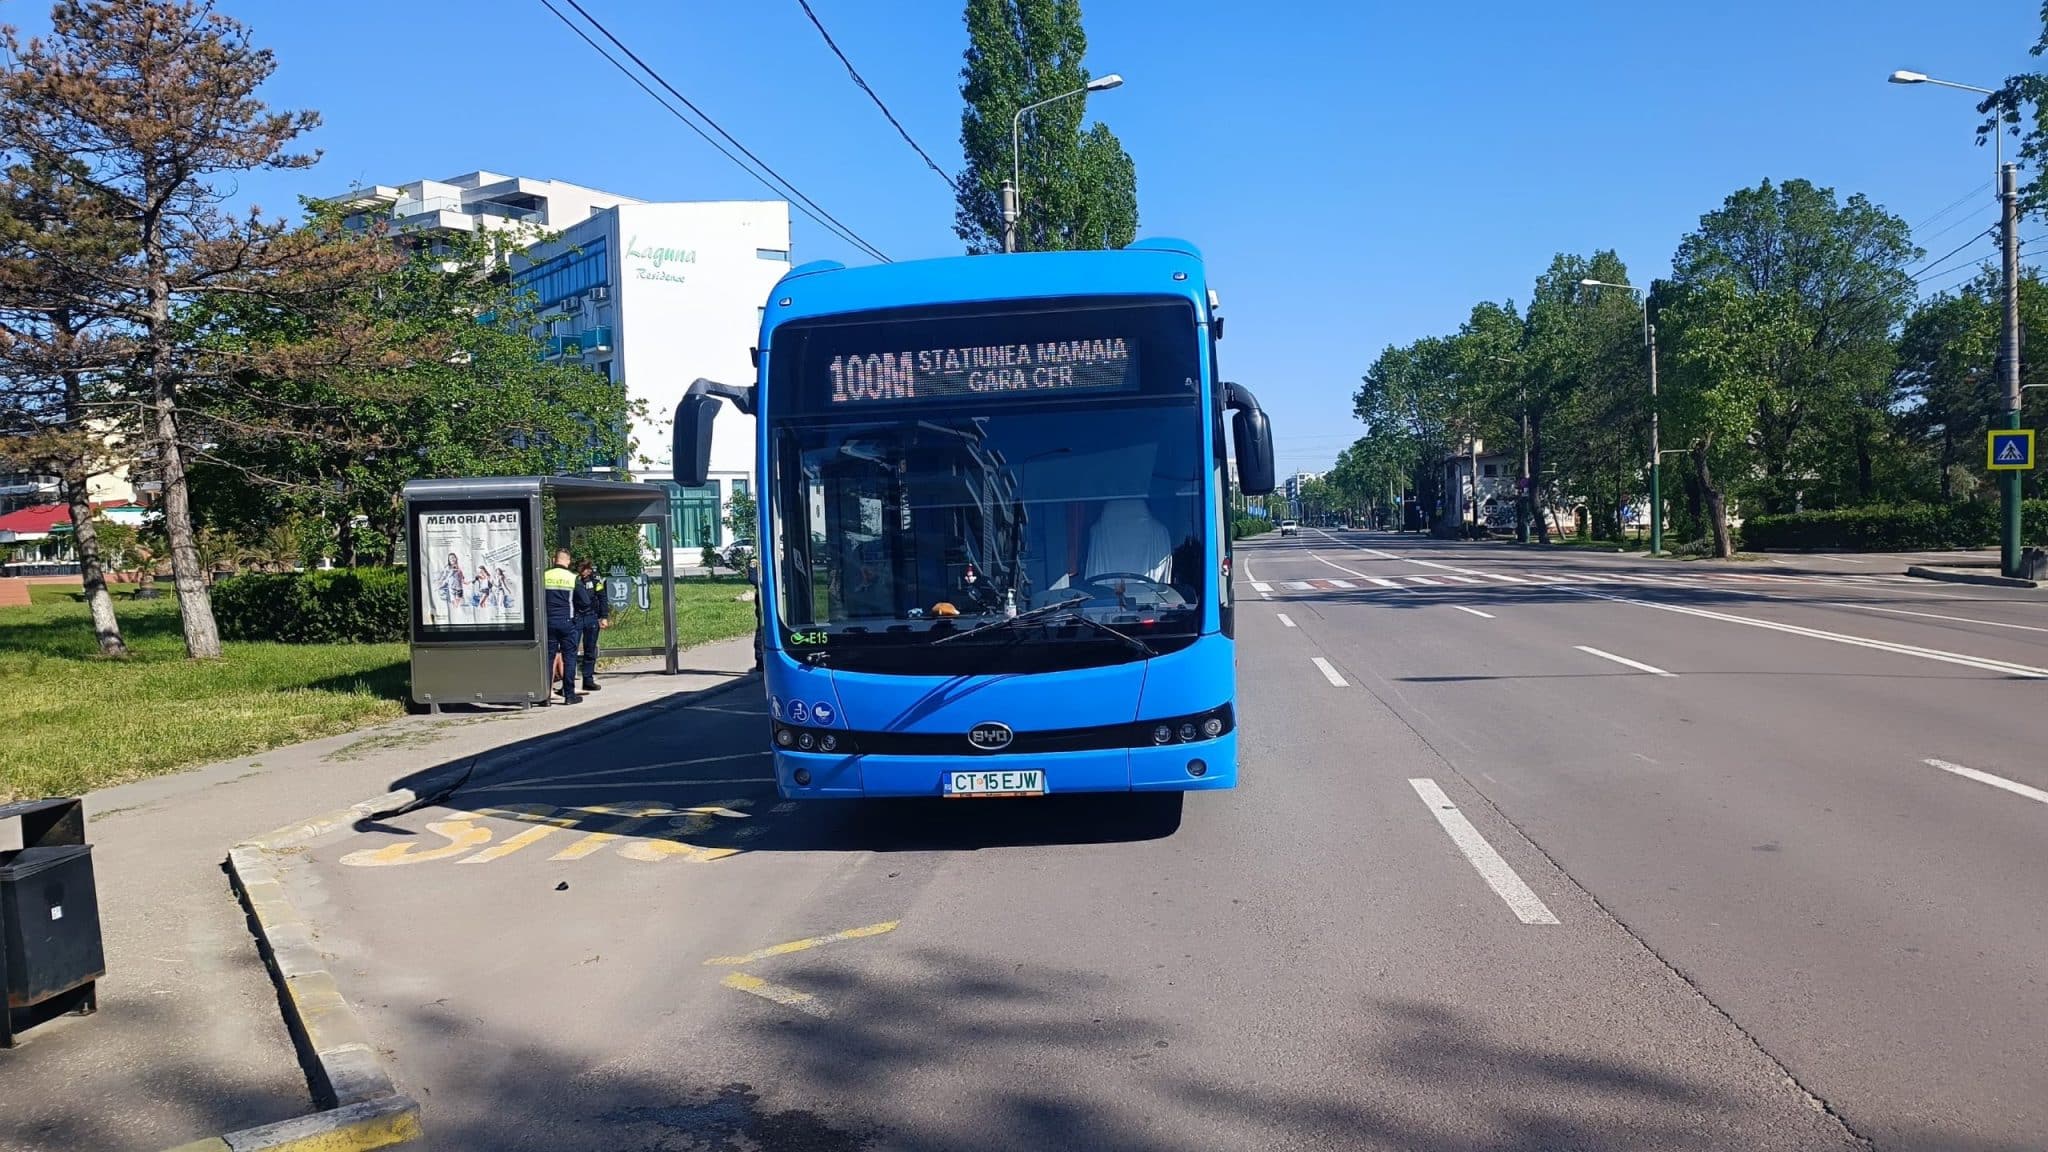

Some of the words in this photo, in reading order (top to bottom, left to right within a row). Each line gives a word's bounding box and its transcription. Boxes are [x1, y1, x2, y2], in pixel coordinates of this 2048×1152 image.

[625, 234, 696, 268] Laguna
[1037, 338, 1127, 363] MAMAIA
[830, 352, 914, 401] 100M
[968, 370, 1026, 391] GARA
[1032, 366, 1073, 387] CFR
[427, 514, 486, 525] MEMORIA
[489, 513, 517, 524] APEI
[809, 632, 828, 644] E15
[972, 730, 1008, 742] BYD
[955, 774, 977, 791] CT
[982, 773, 999, 790] 15
[1002, 772, 1038, 790] EJW
